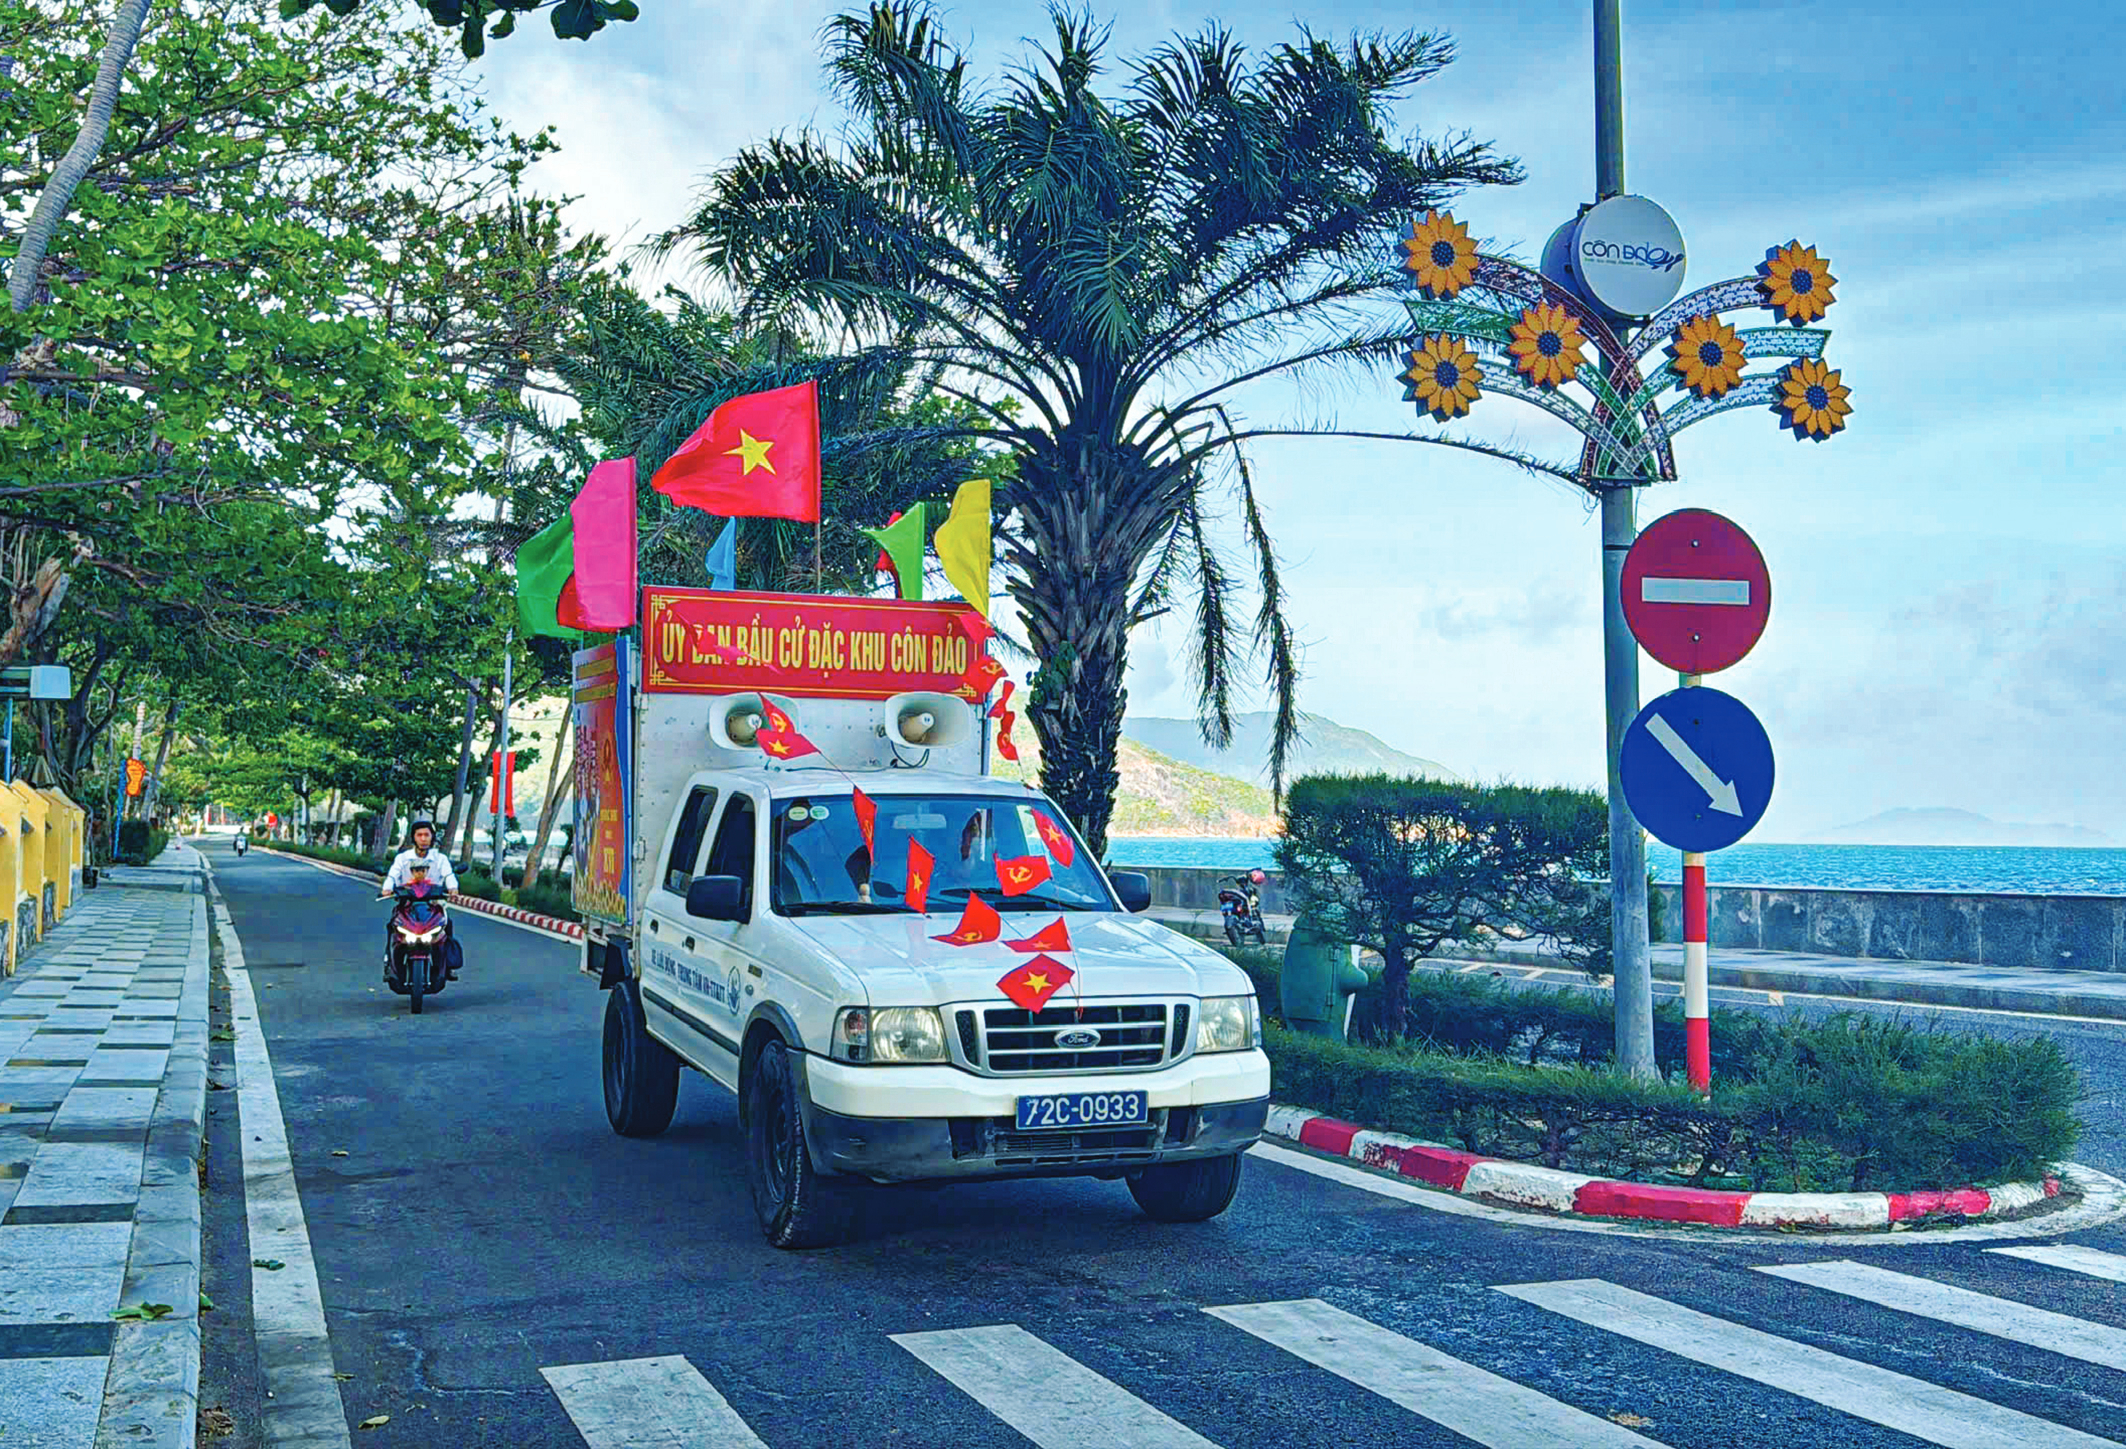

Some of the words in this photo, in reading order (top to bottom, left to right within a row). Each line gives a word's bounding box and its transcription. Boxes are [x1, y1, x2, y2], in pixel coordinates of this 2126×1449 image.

[662, 609, 686, 663] ỦY
[736, 612, 774, 667] BẦU
[779, 614, 806, 669] CỬ
[808, 621, 844, 679] ĐẶC
[850, 631, 886, 672] KHU
[891, 625, 928, 674] CÔN
[931, 622, 967, 675] ĐẢO
[1025, 1093, 1139, 1126] 72C-0933
